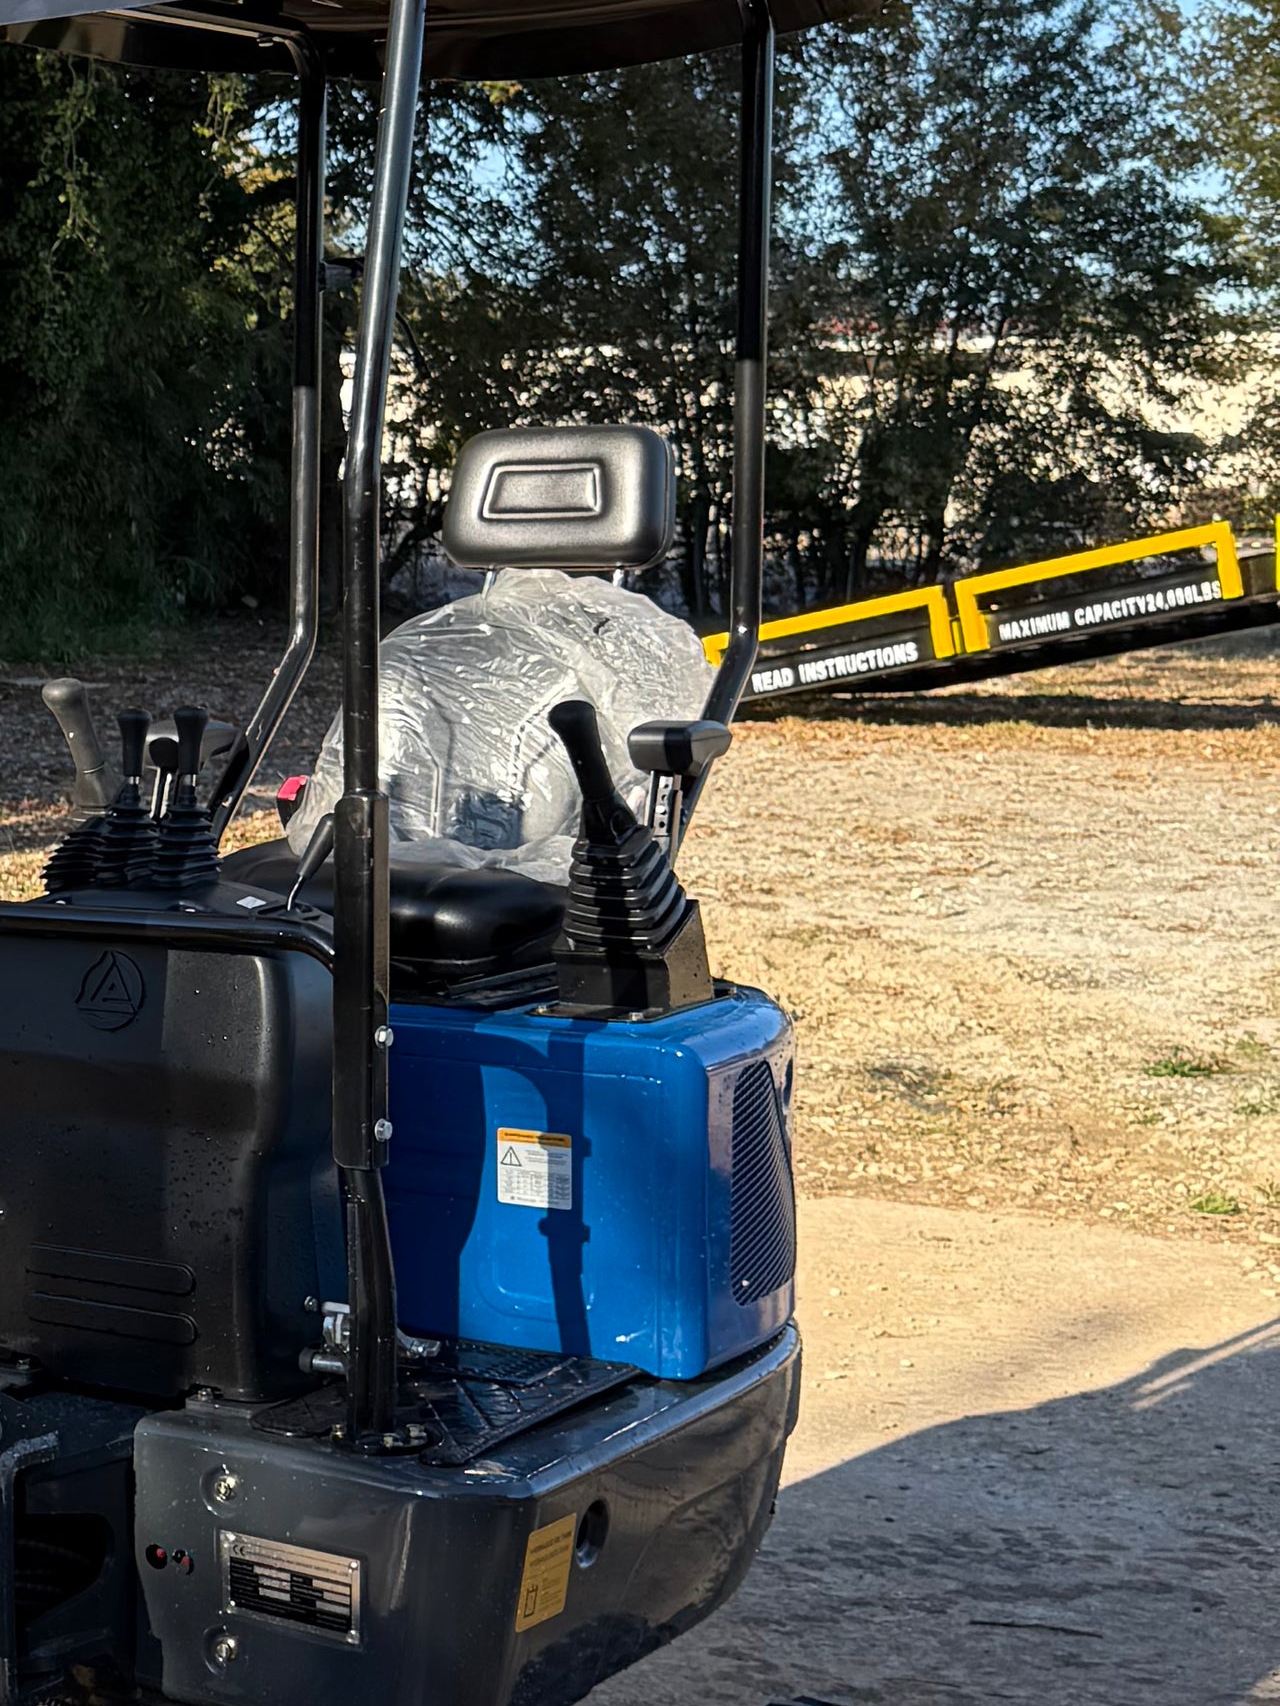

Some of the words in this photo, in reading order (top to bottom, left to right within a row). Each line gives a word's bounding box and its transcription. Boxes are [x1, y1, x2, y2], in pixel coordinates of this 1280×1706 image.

[998, 611, 1071, 641] MAXIMUM
[751, 667, 794, 694] READ
[798, 642, 919, 684] INSTRUCTIONS
